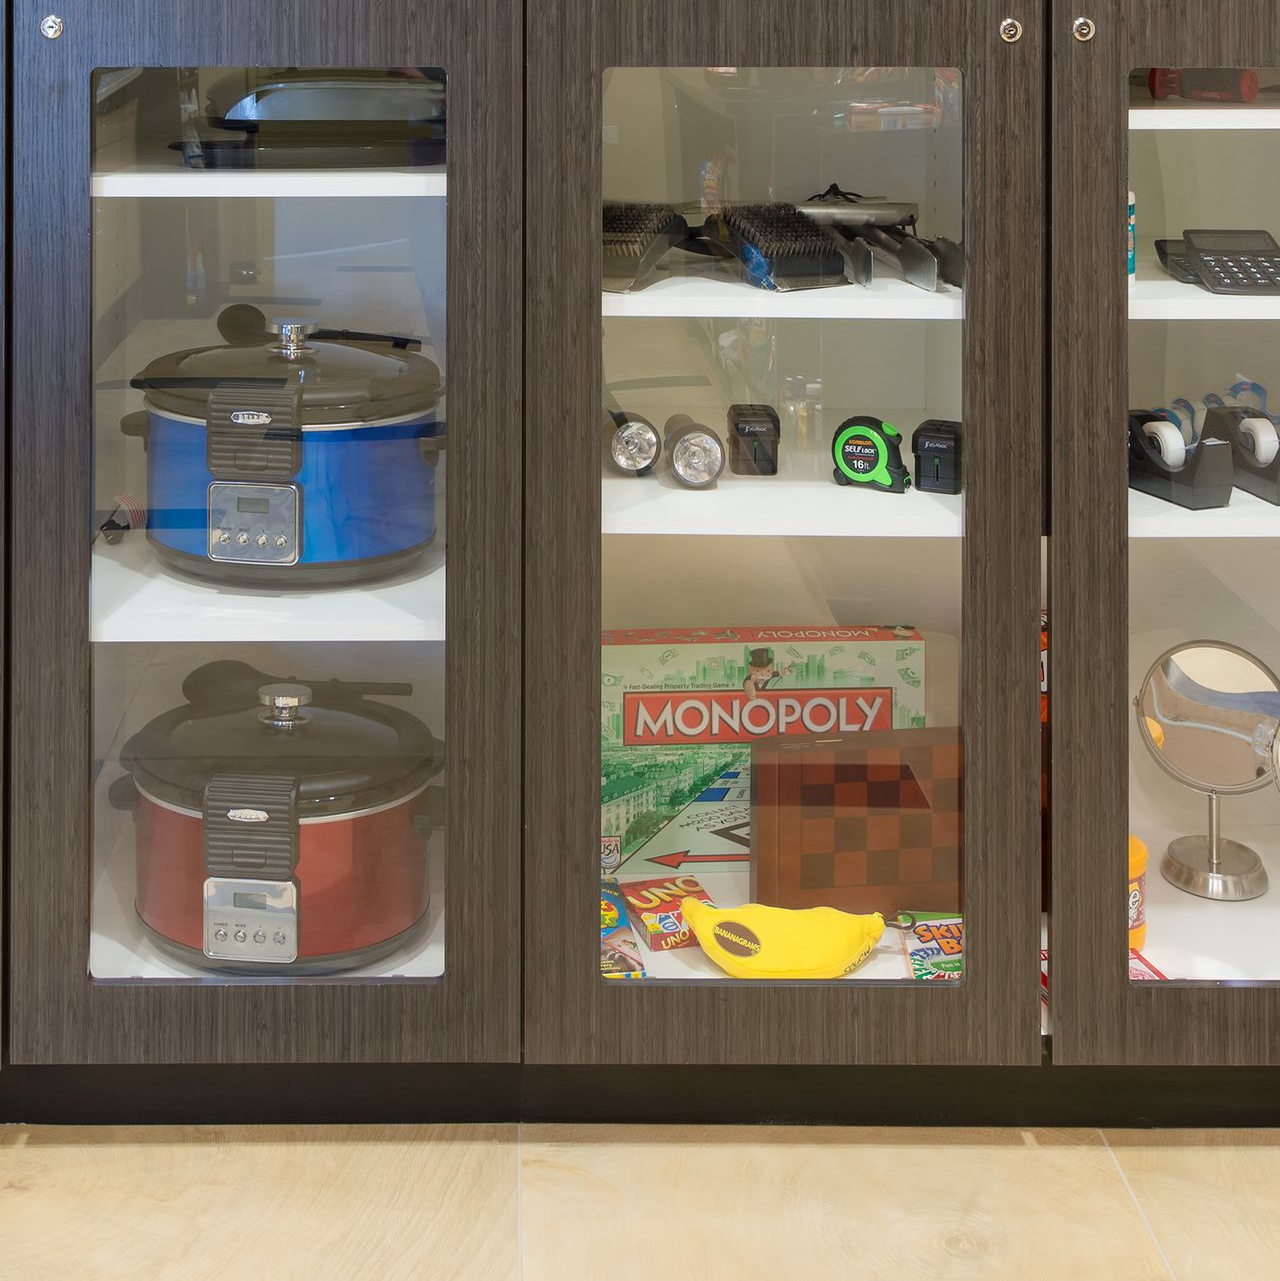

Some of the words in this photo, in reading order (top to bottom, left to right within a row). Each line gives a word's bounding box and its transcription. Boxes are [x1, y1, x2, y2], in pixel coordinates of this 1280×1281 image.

[844, 445, 861, 453] SELF
[757, 629, 872, 638] MONOPOLY
[634, 696, 883, 737] MONOPOLY
[626, 877, 704, 909] UNO
[661, 930, 690, 949] UNO
[714, 926, 761, 953] BANANAGRAMS
